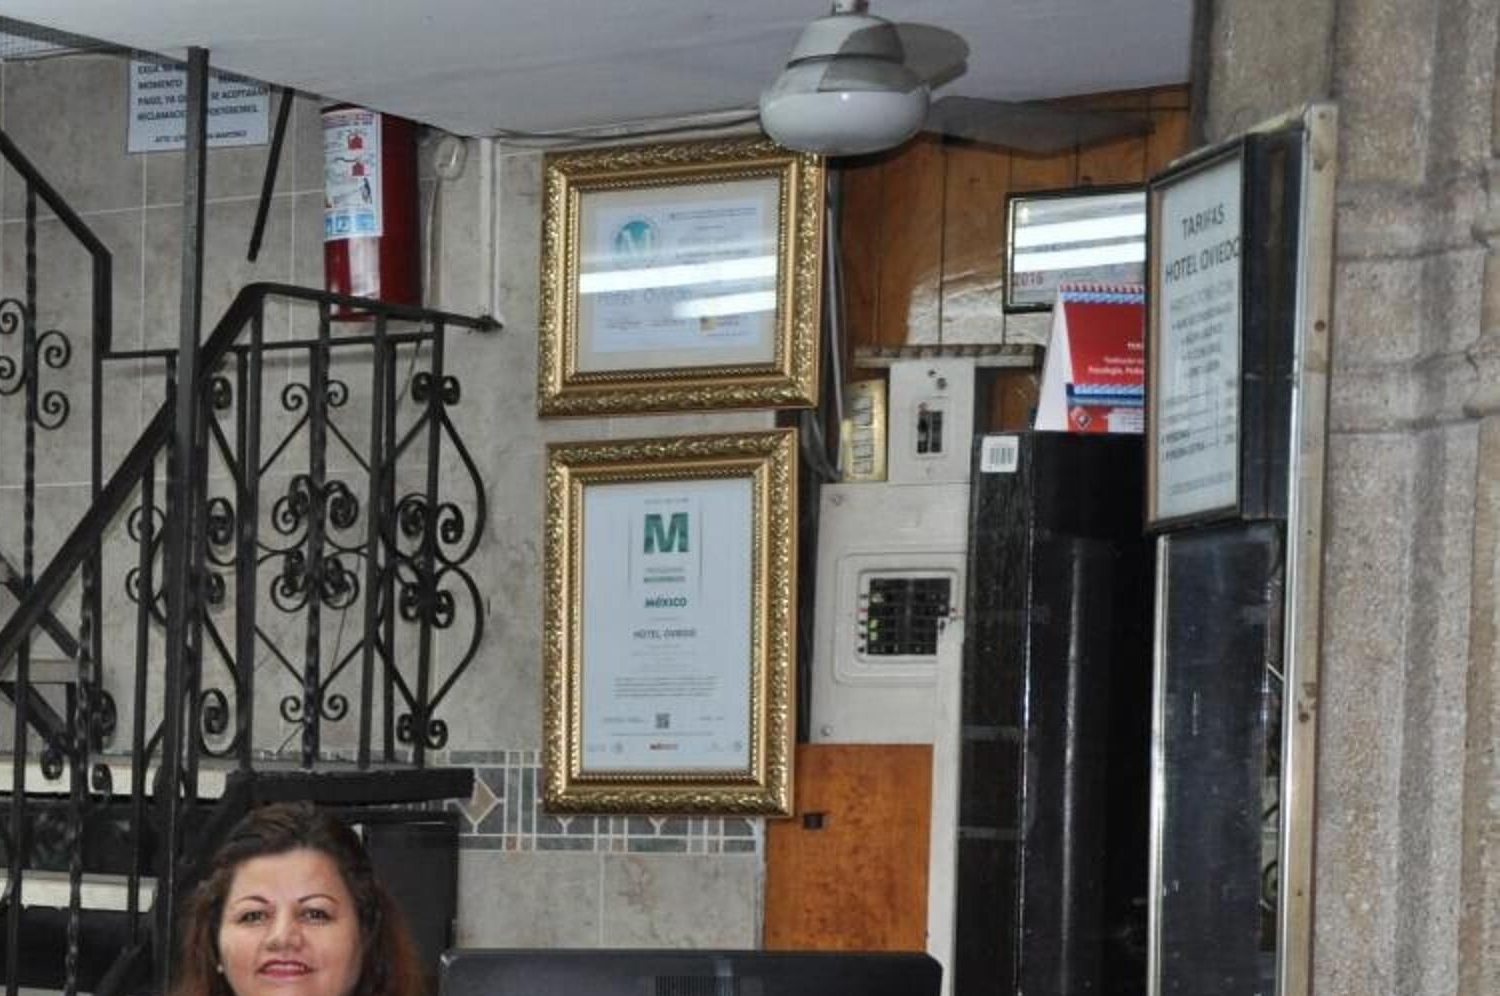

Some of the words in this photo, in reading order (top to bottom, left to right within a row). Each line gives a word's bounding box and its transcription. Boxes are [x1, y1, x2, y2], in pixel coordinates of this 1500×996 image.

[1182, 203, 1225, 240] TARIFAS
[1165, 254, 1198, 285] HOTEL
[643, 511, 689, 554] M
